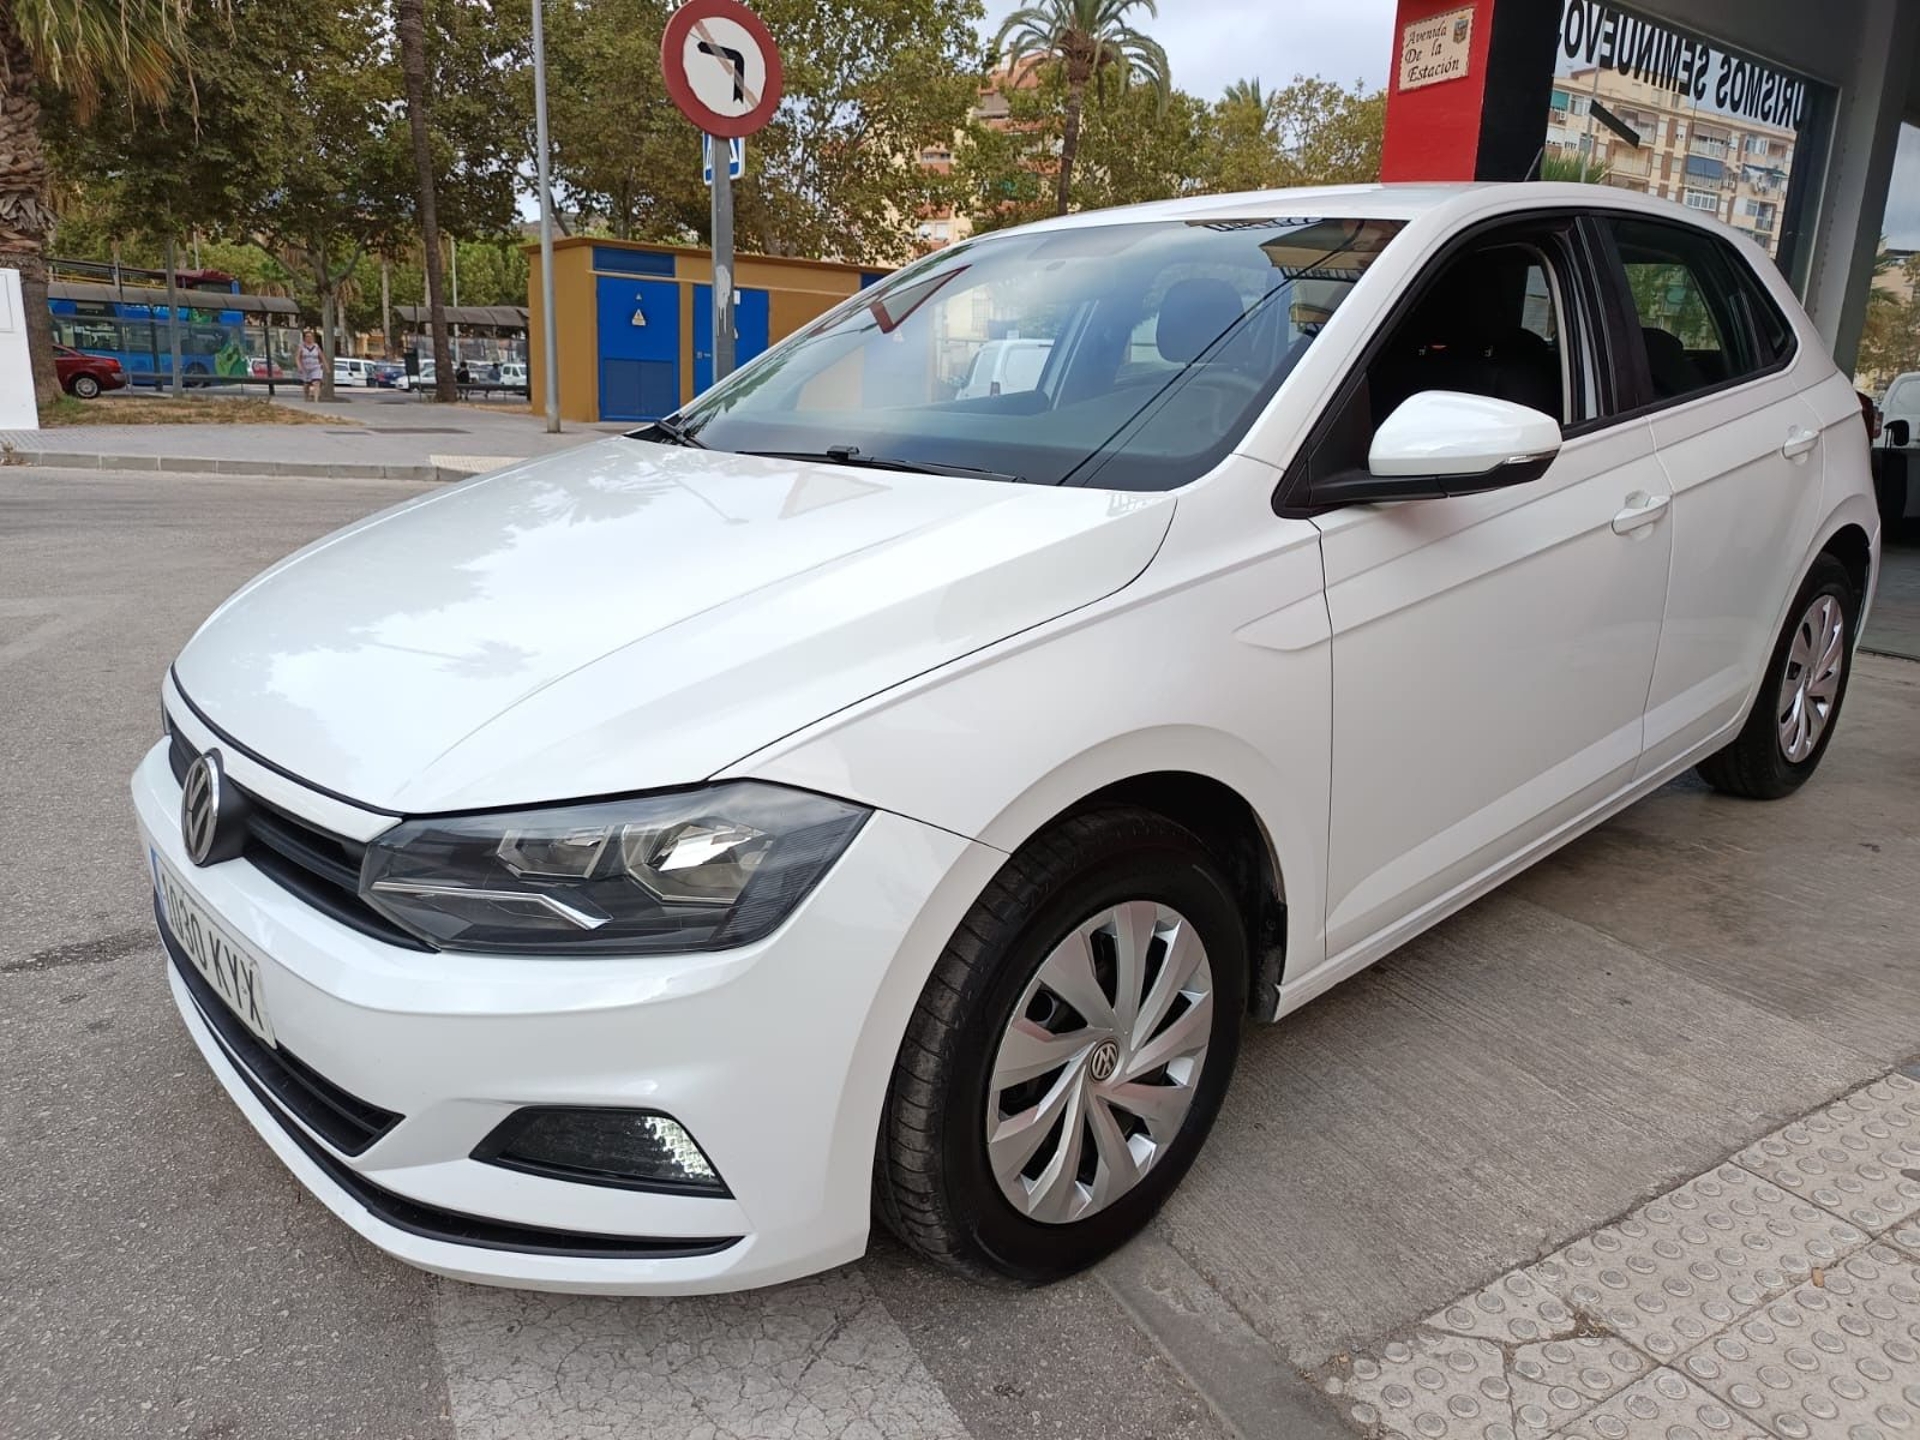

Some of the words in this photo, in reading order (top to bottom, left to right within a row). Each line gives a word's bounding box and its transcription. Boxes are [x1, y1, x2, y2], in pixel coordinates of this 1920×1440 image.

[1405, 20, 1447, 47] Avenida
[1404, 48, 1422, 64] De
[1431, 38, 1442, 57] la
[1408, 56, 1459, 82] Estación
[208, 930, 264, 1031] KYX
